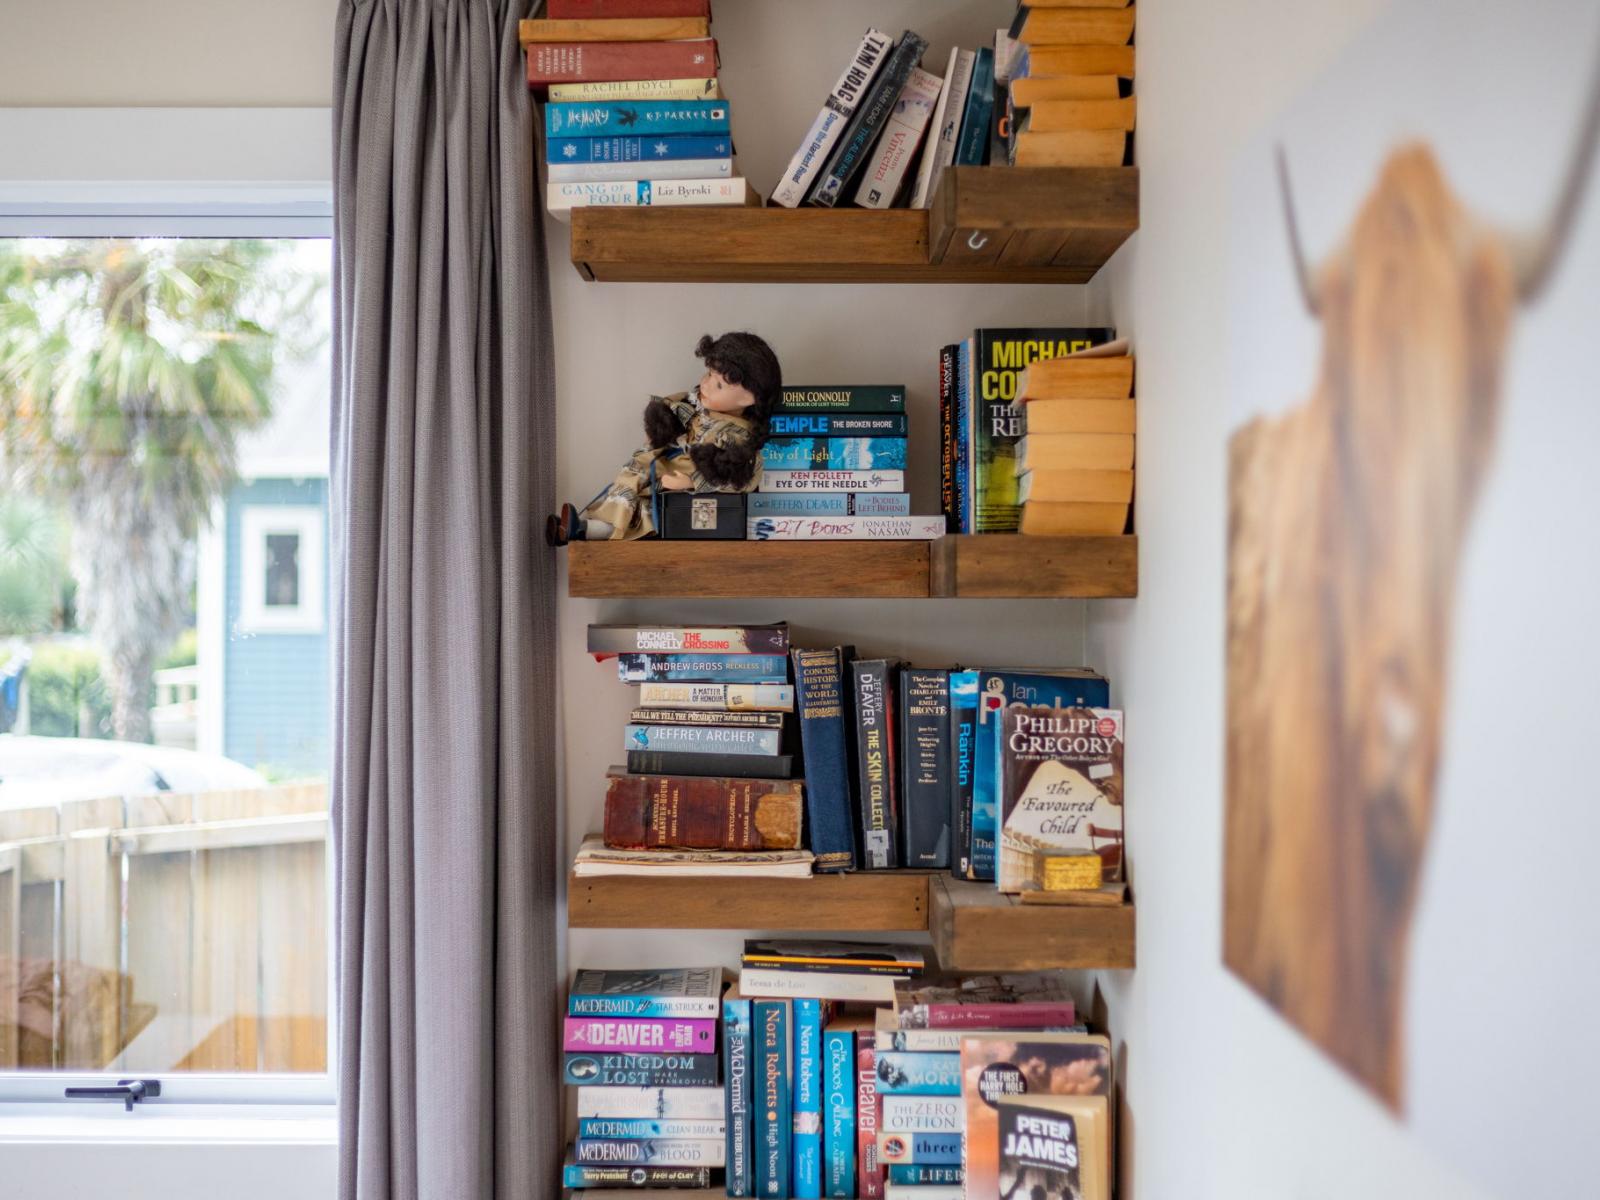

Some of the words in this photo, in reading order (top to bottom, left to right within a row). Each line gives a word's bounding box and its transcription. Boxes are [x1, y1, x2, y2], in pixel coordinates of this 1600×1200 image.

[856, 36, 885, 68] TAMI
[583, 82, 630, 94] RACHEL
[837, 67, 868, 102] HOAG
[826, 112, 838, 130] Down
[802, 141, 821, 169] Darkest
[874, 131, 907, 182] Vincenzi
[562, 183, 606, 196] GANG
[658, 186, 674, 196] Liz
[678, 185, 711, 199] Byrski
[589, 192, 632, 205] FOUR
[992, 340, 1093, 369] MICHA
[783, 391, 805, 405] JOHN
[807, 391, 852, 402] CONNOLLY
[770, 416, 828, 433] TEMPLE
[872, 421, 893, 429] SHORE
[761, 448, 784, 466] City
[787, 448, 798, 461] of
[804, 446, 834, 465] Light
[791, 472, 811, 480] KEN
[813, 471, 853, 480] FOLLETT
[776, 481, 793, 489] EYE
[795, 481, 808, 489] OF
[811, 481, 830, 489] THE
[832, 480, 868, 489] NEEDLE
[806, 499, 843, 510] DEAVER
[944, 481, 952, 513] LIST
[807, 520, 856, 536] Bones
[863, 520, 912, 529] JONATHAN
[868, 528, 911, 537] NASAW
[637, 631, 677, 642] MICHAEL
[684, 632, 701, 642] THE
[637, 640, 683, 650] CONNELLY
[684, 640, 729, 650] CROSSING
[651, 662, 690, 672] ANDREW
[692, 662, 723, 671] GROSS
[803, 667, 837, 676] CONCISE
[803, 675, 838, 684] HISTORY
[692, 687, 698, 696] A
[698, 687, 721, 696] MATTER
[805, 690, 838, 699] WORLD
[873, 677, 882, 713] JEFFERY
[1012, 682, 1037, 699] Ian
[692, 695, 700, 703] OF
[700, 695, 724, 703] HONOUR
[860, 673, 875, 726] DEAVER
[654, 727, 703, 741] JEFFREY
[706, 730, 755, 743] ARCHER
[867, 729, 879, 750] THE
[1009, 733, 1117, 754] GREGORY
[959, 723, 971, 785] Rankin
[867, 752, 882, 782] SKIN
[1046, 780, 1072, 795] The
[870, 785, 884, 831] COLLECTO
[1022, 794, 1103, 812] Favoured
[1039, 814, 1086, 835] Child
[974, 838, 994, 848] The
[592, 1023, 664, 1047] DEAVER
[765, 1009, 781, 1047] Nora
[800, 1025, 812, 1055] Nora
[602, 1056, 695, 1070] KINGDOM
[602, 1071, 649, 1085] LOST
[731, 1044, 746, 1114] McDermid
[766, 1053, 781, 1108] Roberts
[800, 1057, 814, 1104] Roberts
[910, 1071, 960, 1086] MORT
[984, 1071, 997, 1082] THE
[999, 1071, 1019, 1082] FIRST
[980, 1080, 1003, 1092] HARRY
[1005, 1081, 1024, 1093] HOLE
[859, 1070, 877, 1136] Deaver
[893, 1105, 913, 1115] THE
[915, 1102, 957, 1116] ZERO
[830, 1093, 844, 1137] CALLING
[891, 1116, 956, 1129] OPTION
[766, 1122, 779, 1148] High
[1016, 1115, 1071, 1141] PETER
[733, 1120, 743, 1177] RETRIBUTION
[916, 1141, 957, 1154] three
[1004, 1132, 1078, 1168] JAMES
[660, 1150, 701, 1161] BLOOD
[768, 1150, 779, 1178] Noon
[584, 1173, 600, 1181] Terry
[919, 1169, 962, 1182] LIFEB
